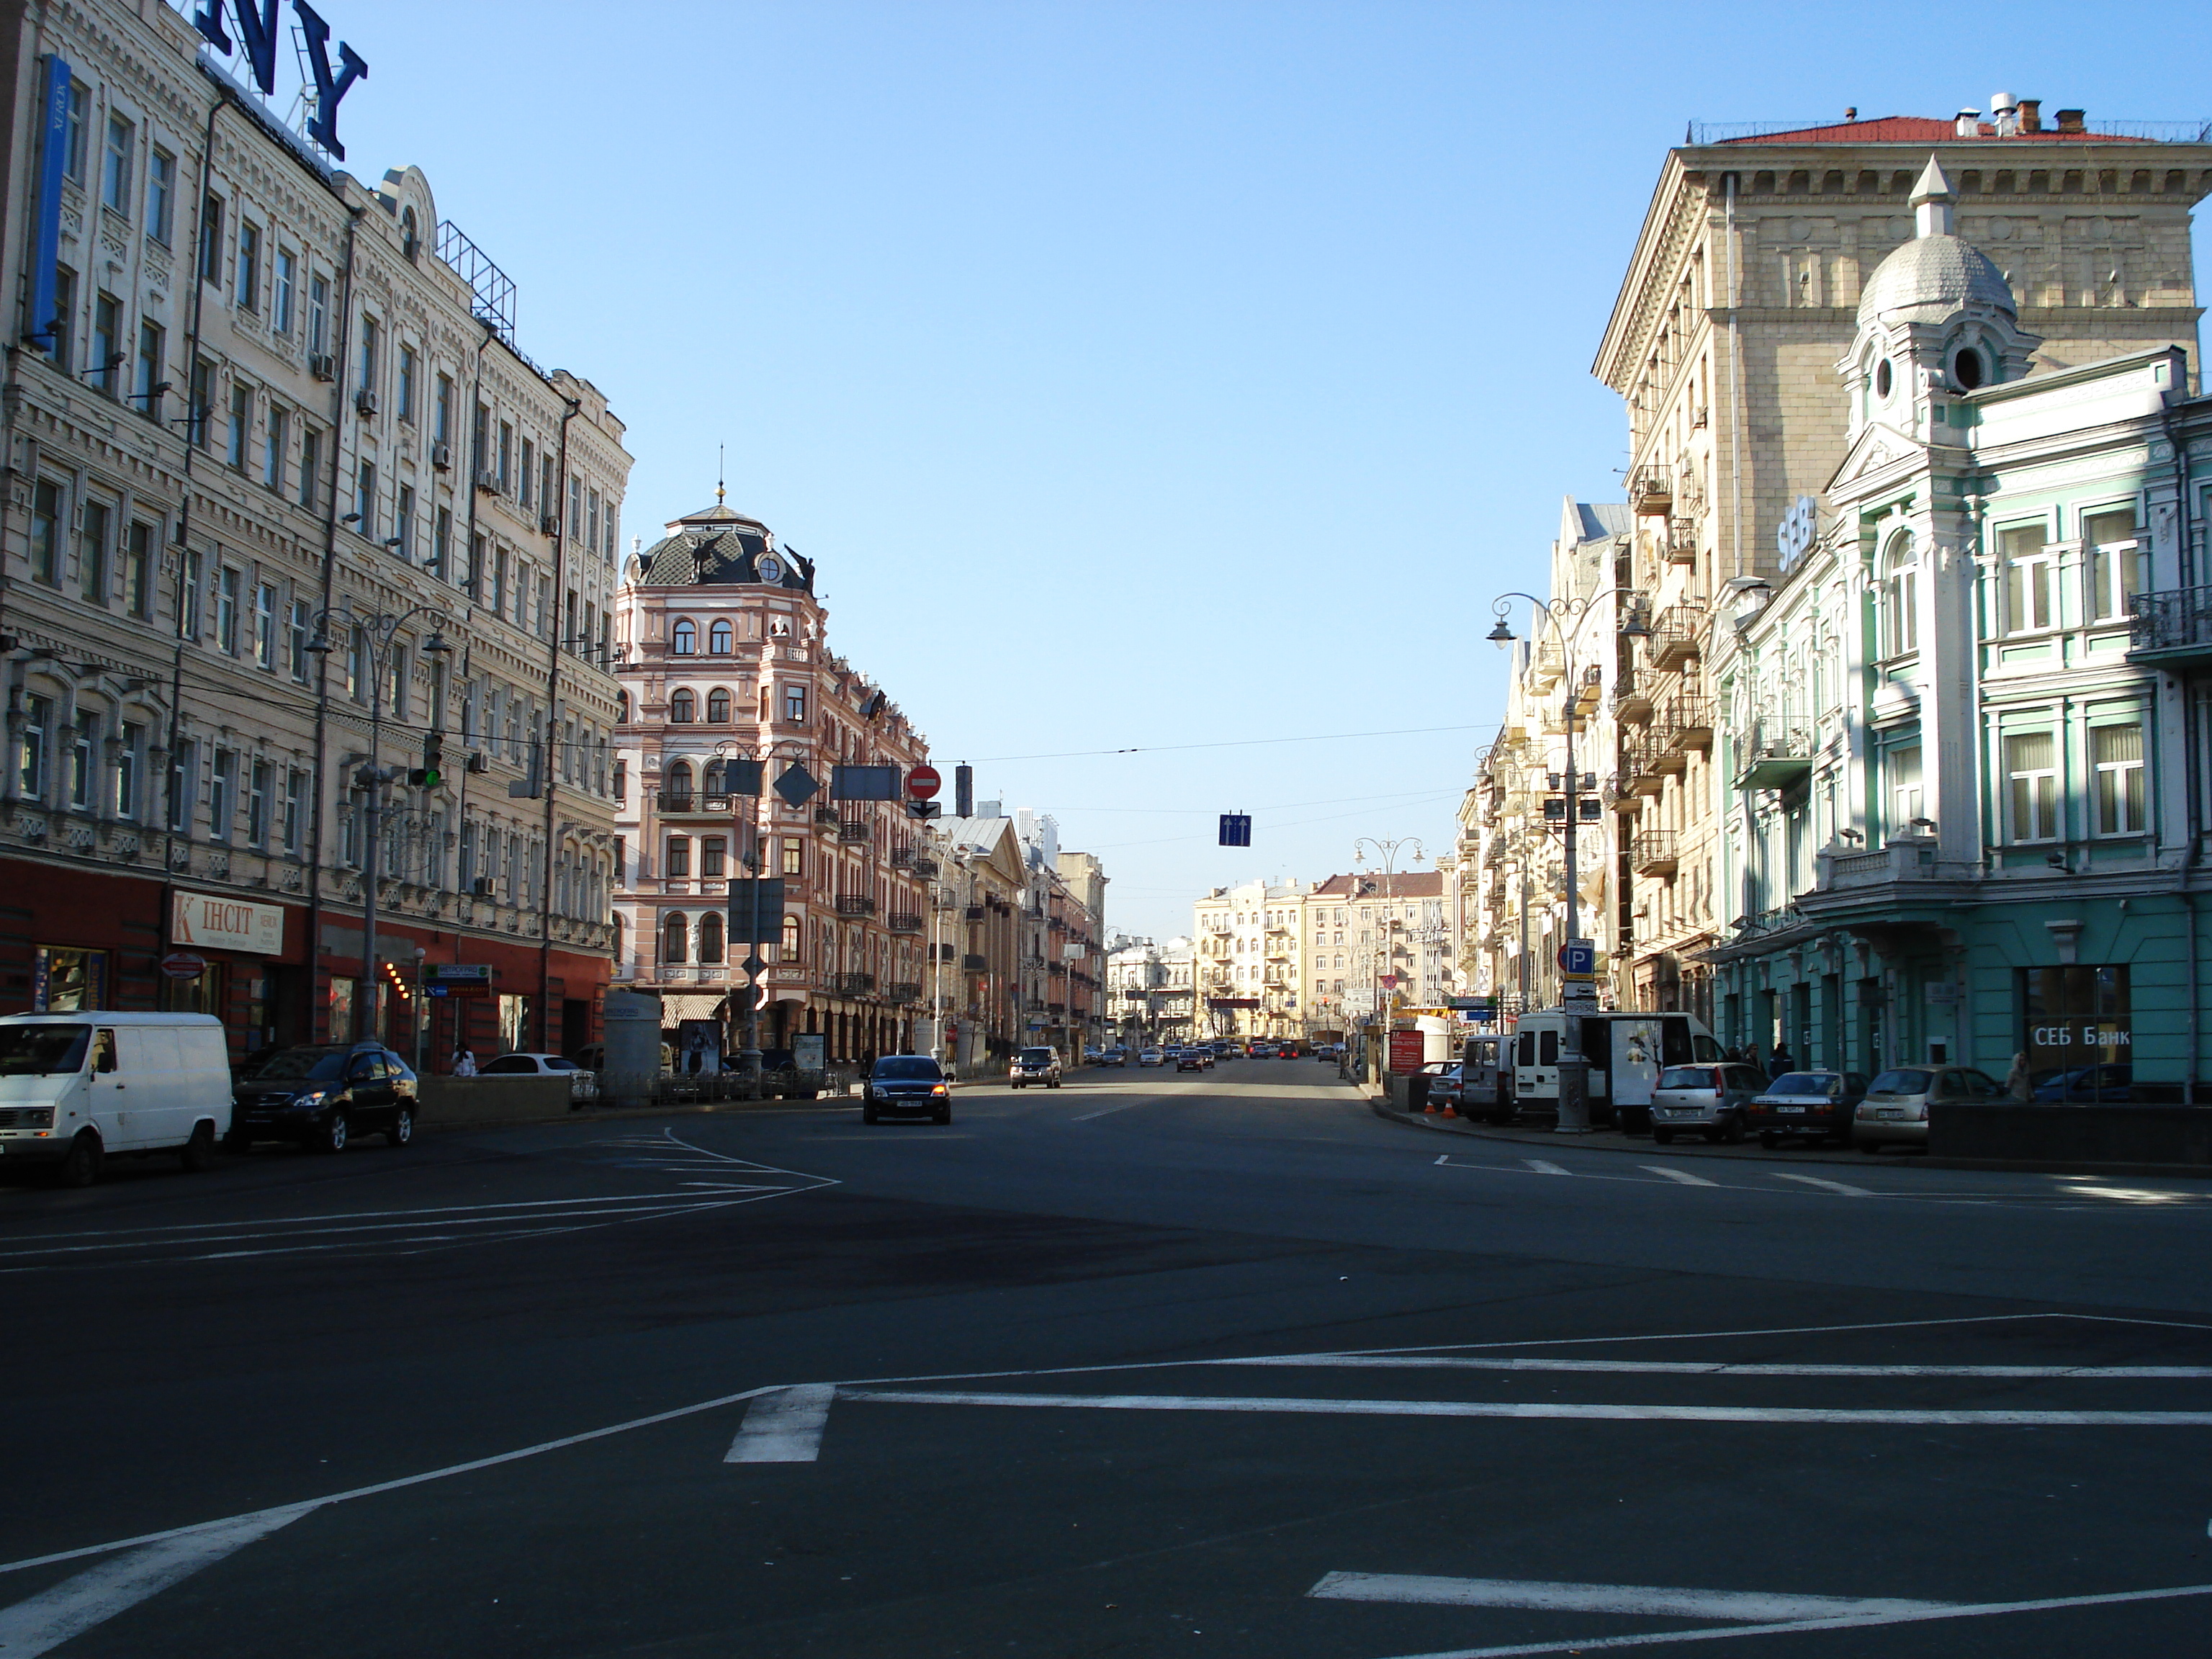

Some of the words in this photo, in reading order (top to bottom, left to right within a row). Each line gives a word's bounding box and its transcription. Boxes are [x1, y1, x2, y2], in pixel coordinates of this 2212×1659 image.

[53, 81, 66, 134] XEROX
[1777, 495, 1817, 572] SEB
[1572, 950, 1586, 970] P
[2034, 1027, 2072, 1046] СЕБ
[2082, 1026, 2131, 1046] Банк
